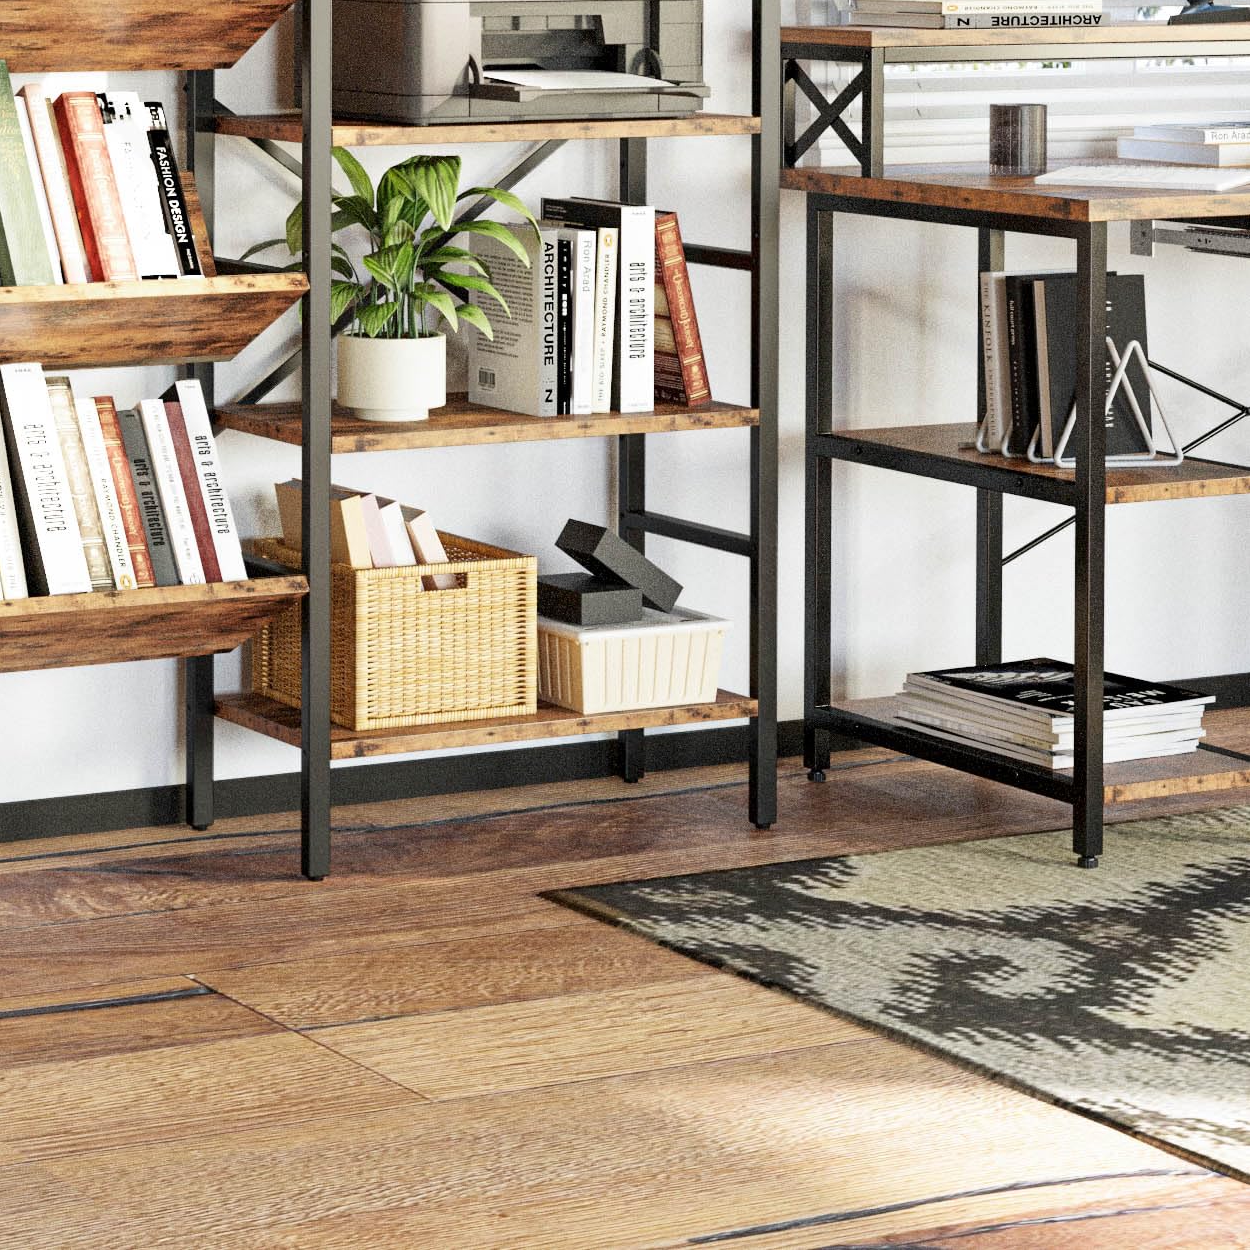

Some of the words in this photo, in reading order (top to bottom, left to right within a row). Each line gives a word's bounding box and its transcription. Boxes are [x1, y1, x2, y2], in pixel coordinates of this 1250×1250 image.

[990, 14, 1101, 25] ARCHITECTURE
[155, 144, 177, 198] FASHION
[168, 198, 188, 244] DESIGN
[582, 240, 592, 262] Ron
[629, 262, 647, 281] arts
[582, 266, 591, 291] Arad
[543, 241, 554, 367] ARCHITECTURE
[629, 298, 648, 358] architecture
[983, 304, 993, 362] KINFOLK
[544, 388, 553, 403] N
[22, 420, 48, 448] arts
[193, 433, 212, 456] arts
[132, 456, 150, 478] arts
[32, 459, 68, 535] architecture
[139, 489, 167, 547] architecture
[202, 470, 231, 535] architecture
[100, 477, 115, 521] RAYMOND
[110, 523, 126, 567] CHANDLER
